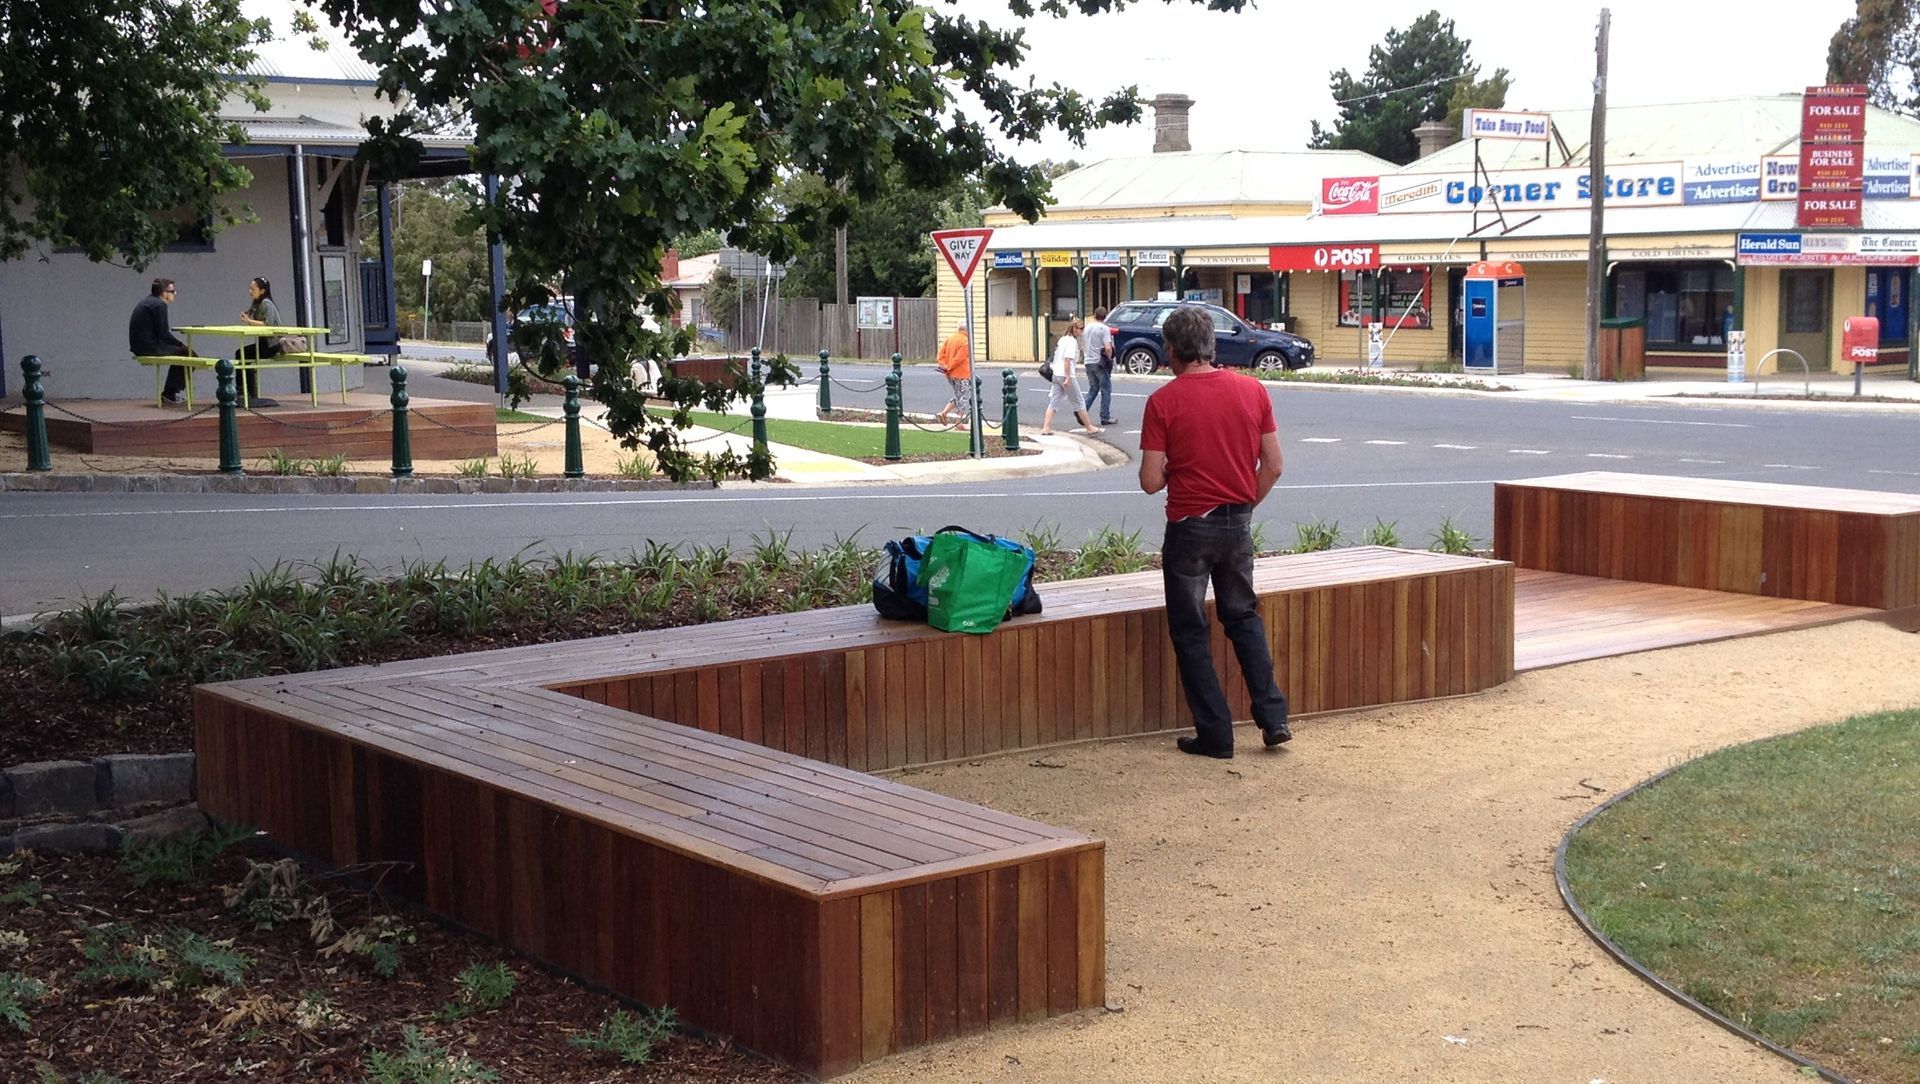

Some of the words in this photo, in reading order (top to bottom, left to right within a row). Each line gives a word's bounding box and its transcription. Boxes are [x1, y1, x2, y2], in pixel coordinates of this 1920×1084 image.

[1810, 106, 1831, 115] FOR
[1833, 105, 1860, 115] SALE
[1475, 118, 1496, 131] Take
[1499, 119, 1522, 135] Away
[1525, 120, 1545, 134] Food
[1812, 150, 1853, 158] BUSINESS
[1809, 158, 1829, 166] FOR
[1831, 158, 1855, 166] SALE
[1867, 157, 1909, 171] Advertiser
[1695, 161, 1759, 176] Advertiser
[1694, 184, 1759, 199] Advertiser
[1866, 179, 1909, 194] Advertiser
[1385, 183, 1438, 206] Meredith
[1804, 201, 1827, 210] FOR
[1829, 200, 1857, 210] SALE
[950, 240, 976, 250] GIVE
[1741, 238, 1776, 250] Herald
[1778, 239, 1800, 250] Sun
[1862, 236, 1879, 247] The
[1882, 237, 1917, 247] Courier
[955, 252, 971, 260] WAY
[1331, 248, 1373, 265] POST
[1398, 253, 1462, 261] GROCERIES
[1509, 251, 1579, 259] AMMUNITION
[1667, 249, 1711, 257] DRINKS
[1041, 254, 1070, 265] Sunday
[1852, 347, 1878, 357] POST
